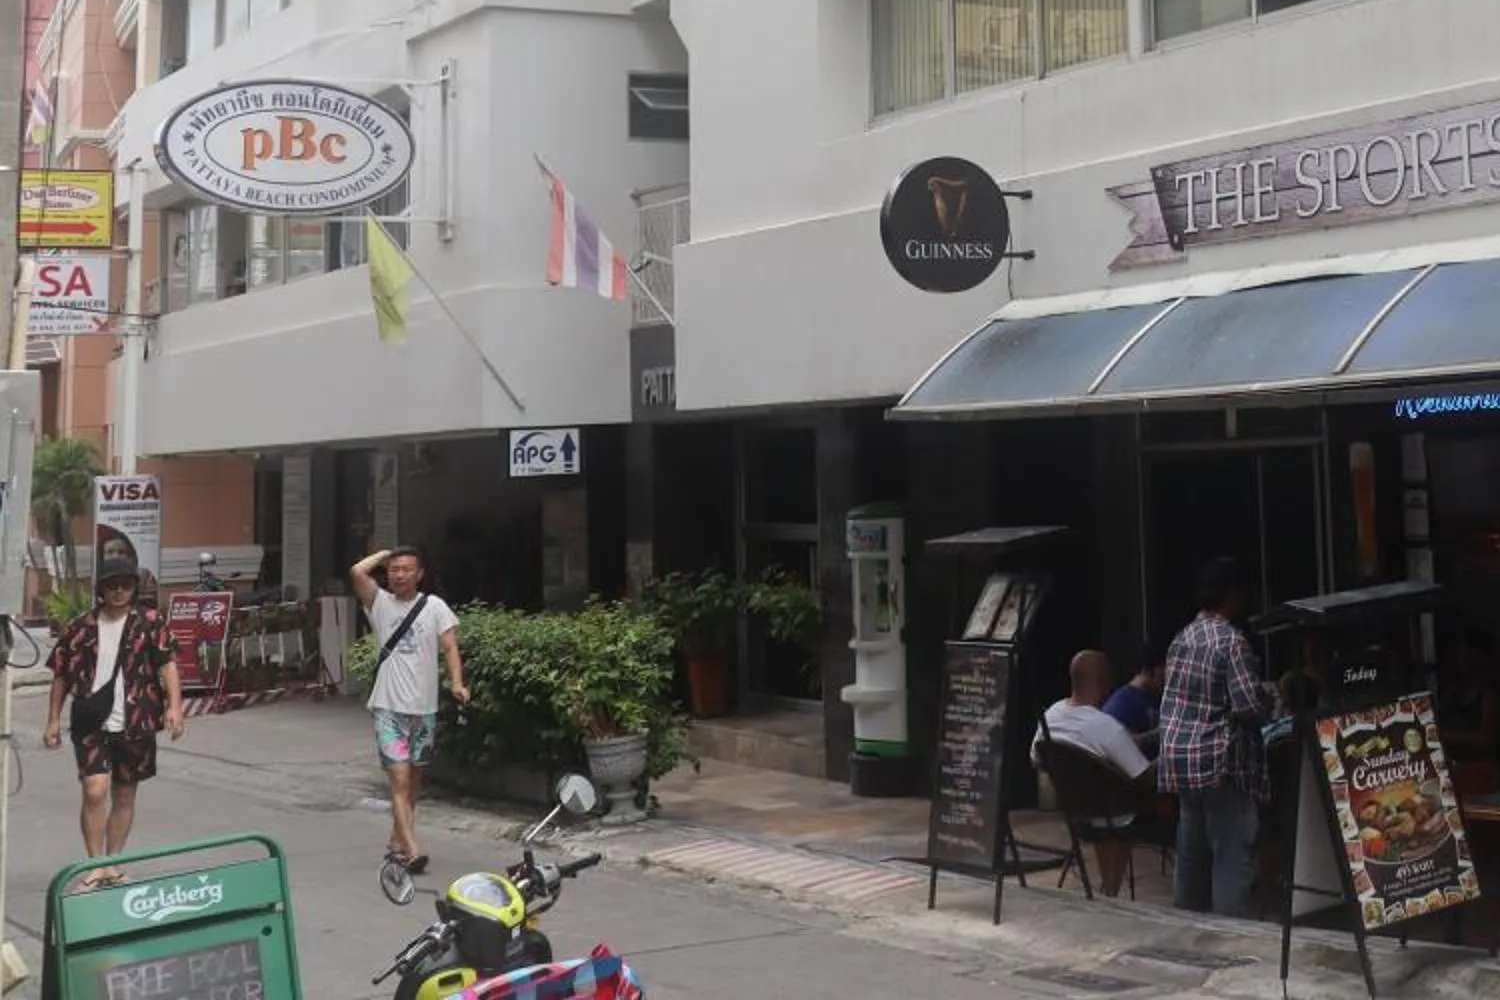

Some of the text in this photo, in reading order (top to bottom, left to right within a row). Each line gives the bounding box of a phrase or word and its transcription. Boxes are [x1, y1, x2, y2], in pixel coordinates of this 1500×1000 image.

[183, 147, 397, 206] PATTAYA BEACH CONDOMINIUM
[1175, 157, 1279, 234] THE
[641, 366, 675, 406] PATT
[513, 445, 557, 464] APG
[101, 483, 160, 501] VISA
[1352, 758, 1428, 791] Carvery
[1363, 747, 1410, 769] Sunday
[122, 880, 224, 920] Carlsberg
[187, 943, 260, 989] POOL
